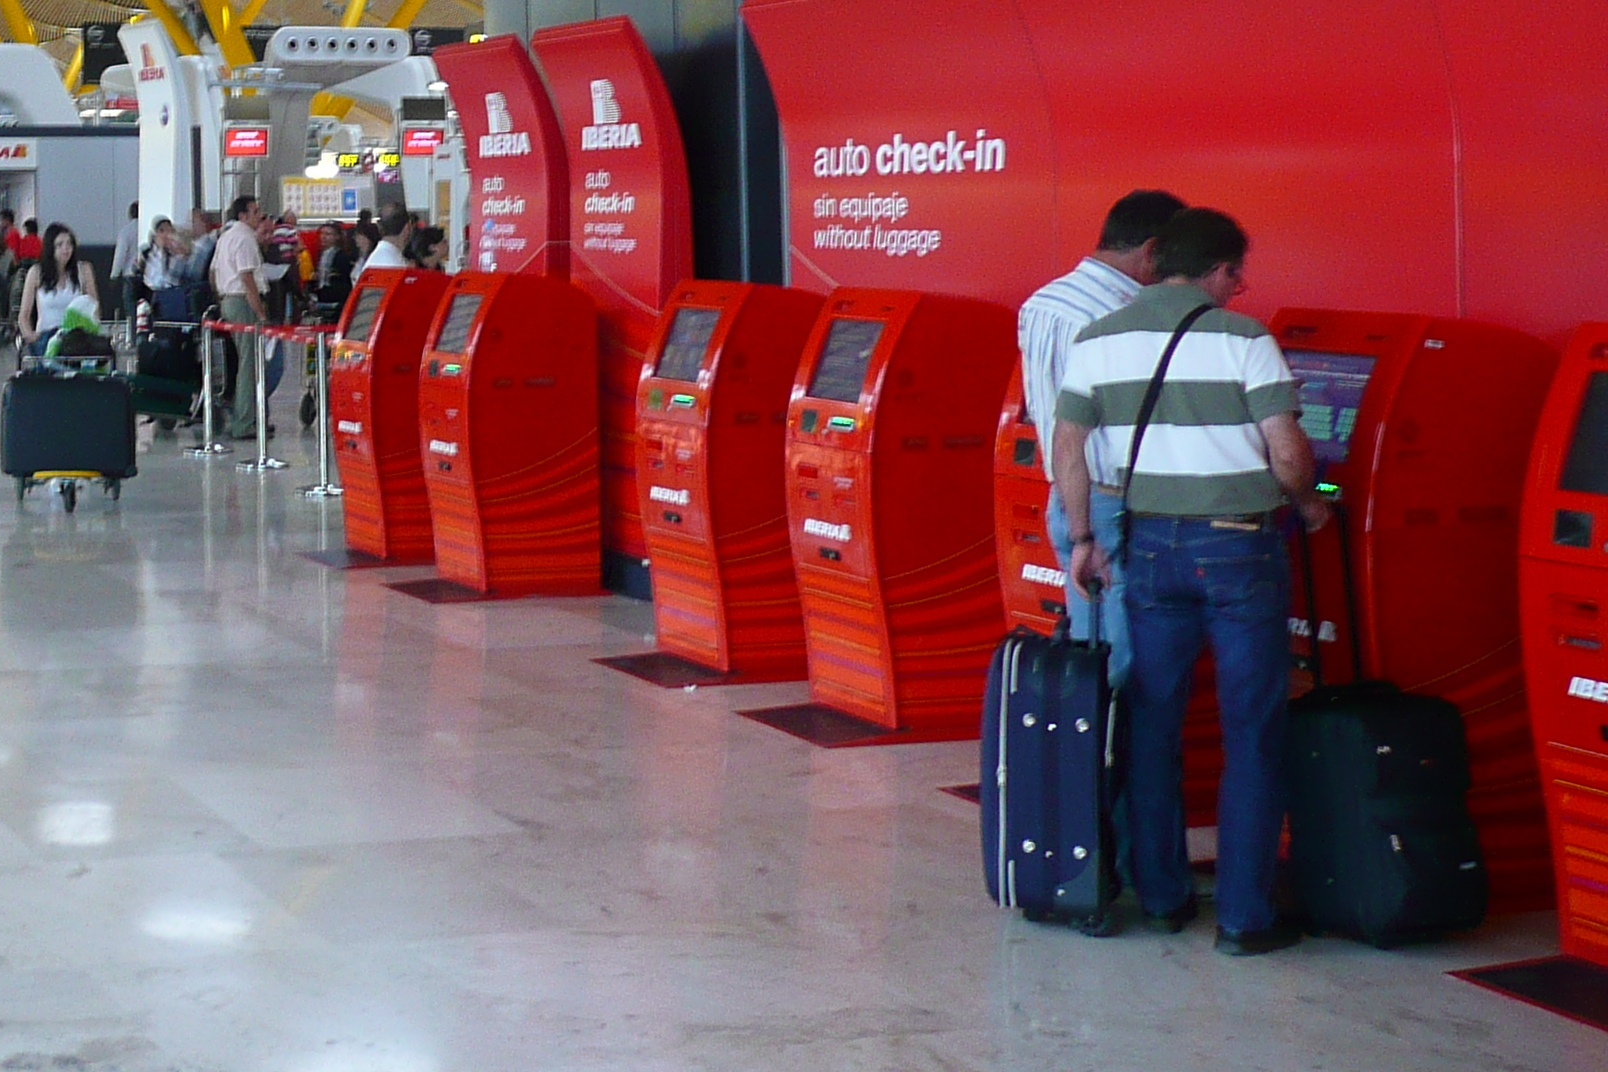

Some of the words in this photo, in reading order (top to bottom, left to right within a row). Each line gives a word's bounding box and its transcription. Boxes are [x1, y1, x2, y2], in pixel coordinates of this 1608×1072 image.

[479, 132, 532, 159] IBERIA
[581, 122, 643, 151] IBERIA
[814, 138, 871, 177] auto
[875, 128, 1006, 175] check-in
[482, 175, 505, 194] auto
[585, 169, 612, 190] auto
[482, 195, 526, 217] check-in
[584, 192, 635, 215] check-in
[814, 192, 838, 219] sin
[839, 191, 910, 224] equipaje
[814, 224, 873, 250] without
[873, 224, 942, 257] luggage
[649, 485, 682, 505] IBERIA
[803, 518, 844, 540] IBERIA
[1567, 676, 1608, 704] IBE
